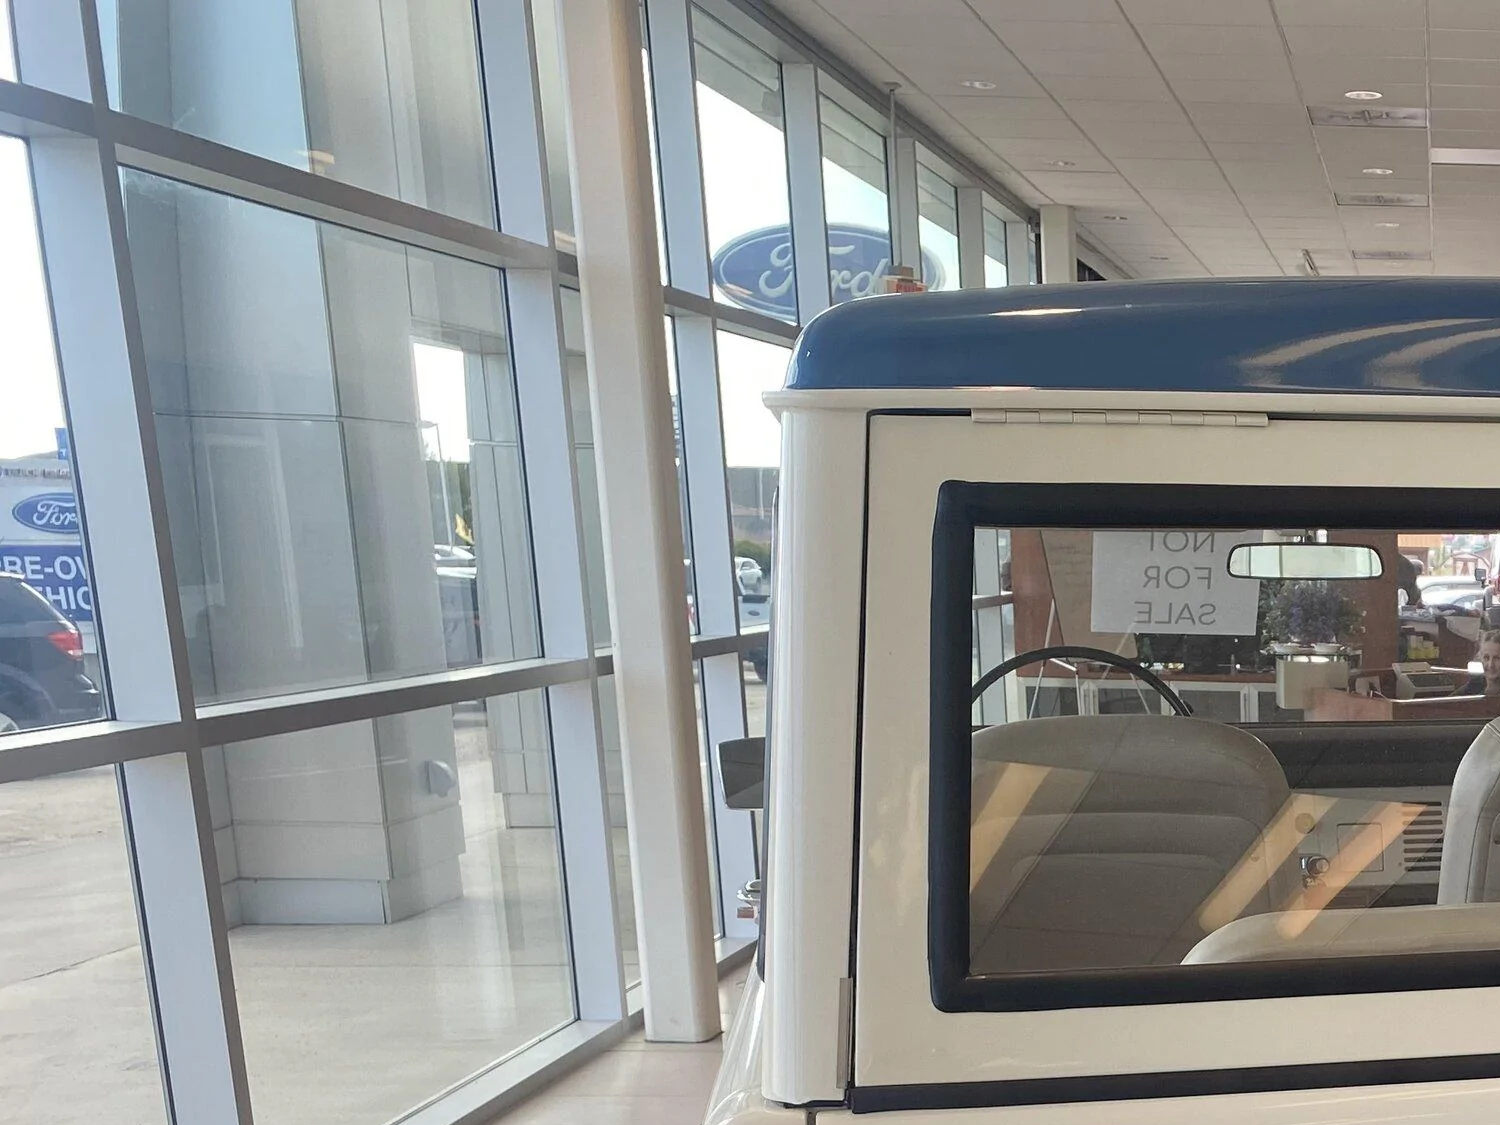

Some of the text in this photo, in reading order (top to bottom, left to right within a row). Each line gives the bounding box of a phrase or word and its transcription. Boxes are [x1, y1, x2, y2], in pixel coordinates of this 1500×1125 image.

[758, 243, 889, 298] Frd
[33, 500, 78, 526] For
[0, 555, 86, 580] RE-O
